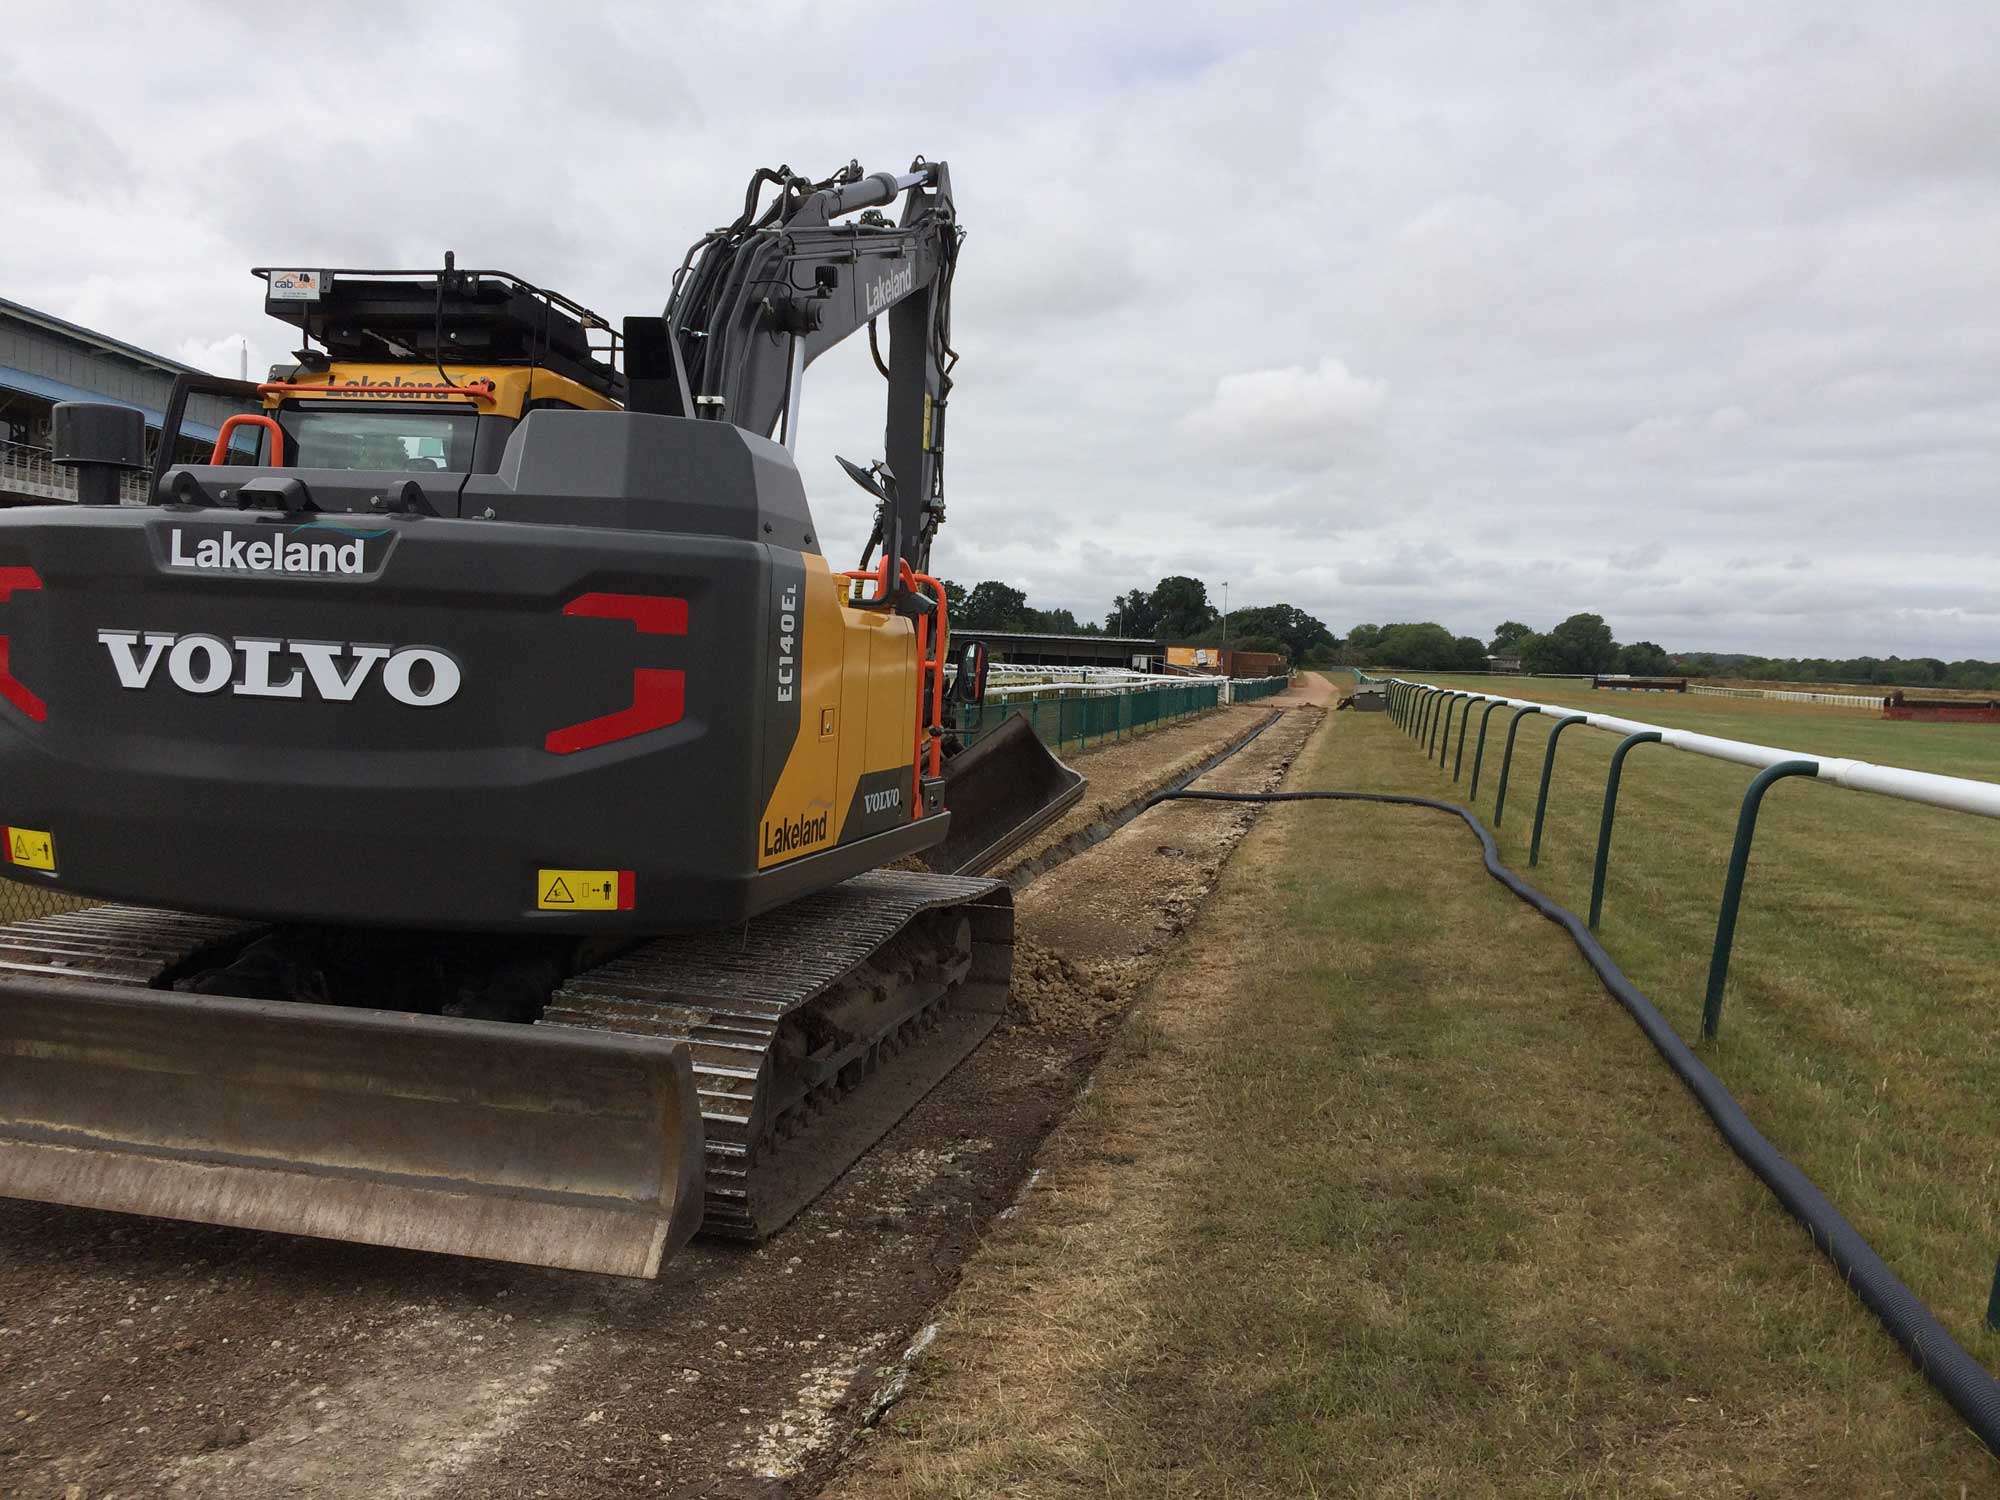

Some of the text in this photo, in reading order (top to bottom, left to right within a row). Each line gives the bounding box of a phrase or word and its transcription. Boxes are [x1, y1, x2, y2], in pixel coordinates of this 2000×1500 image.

[865, 261, 912, 315] Lakeland
[326, 374, 449, 400] Lakeland
[170, 528, 365, 574] Lakeland
[98, 629, 462, 706] VOLVO
[864, 788, 900, 814] VOLVO
[764, 810, 828, 857] Lakeland
